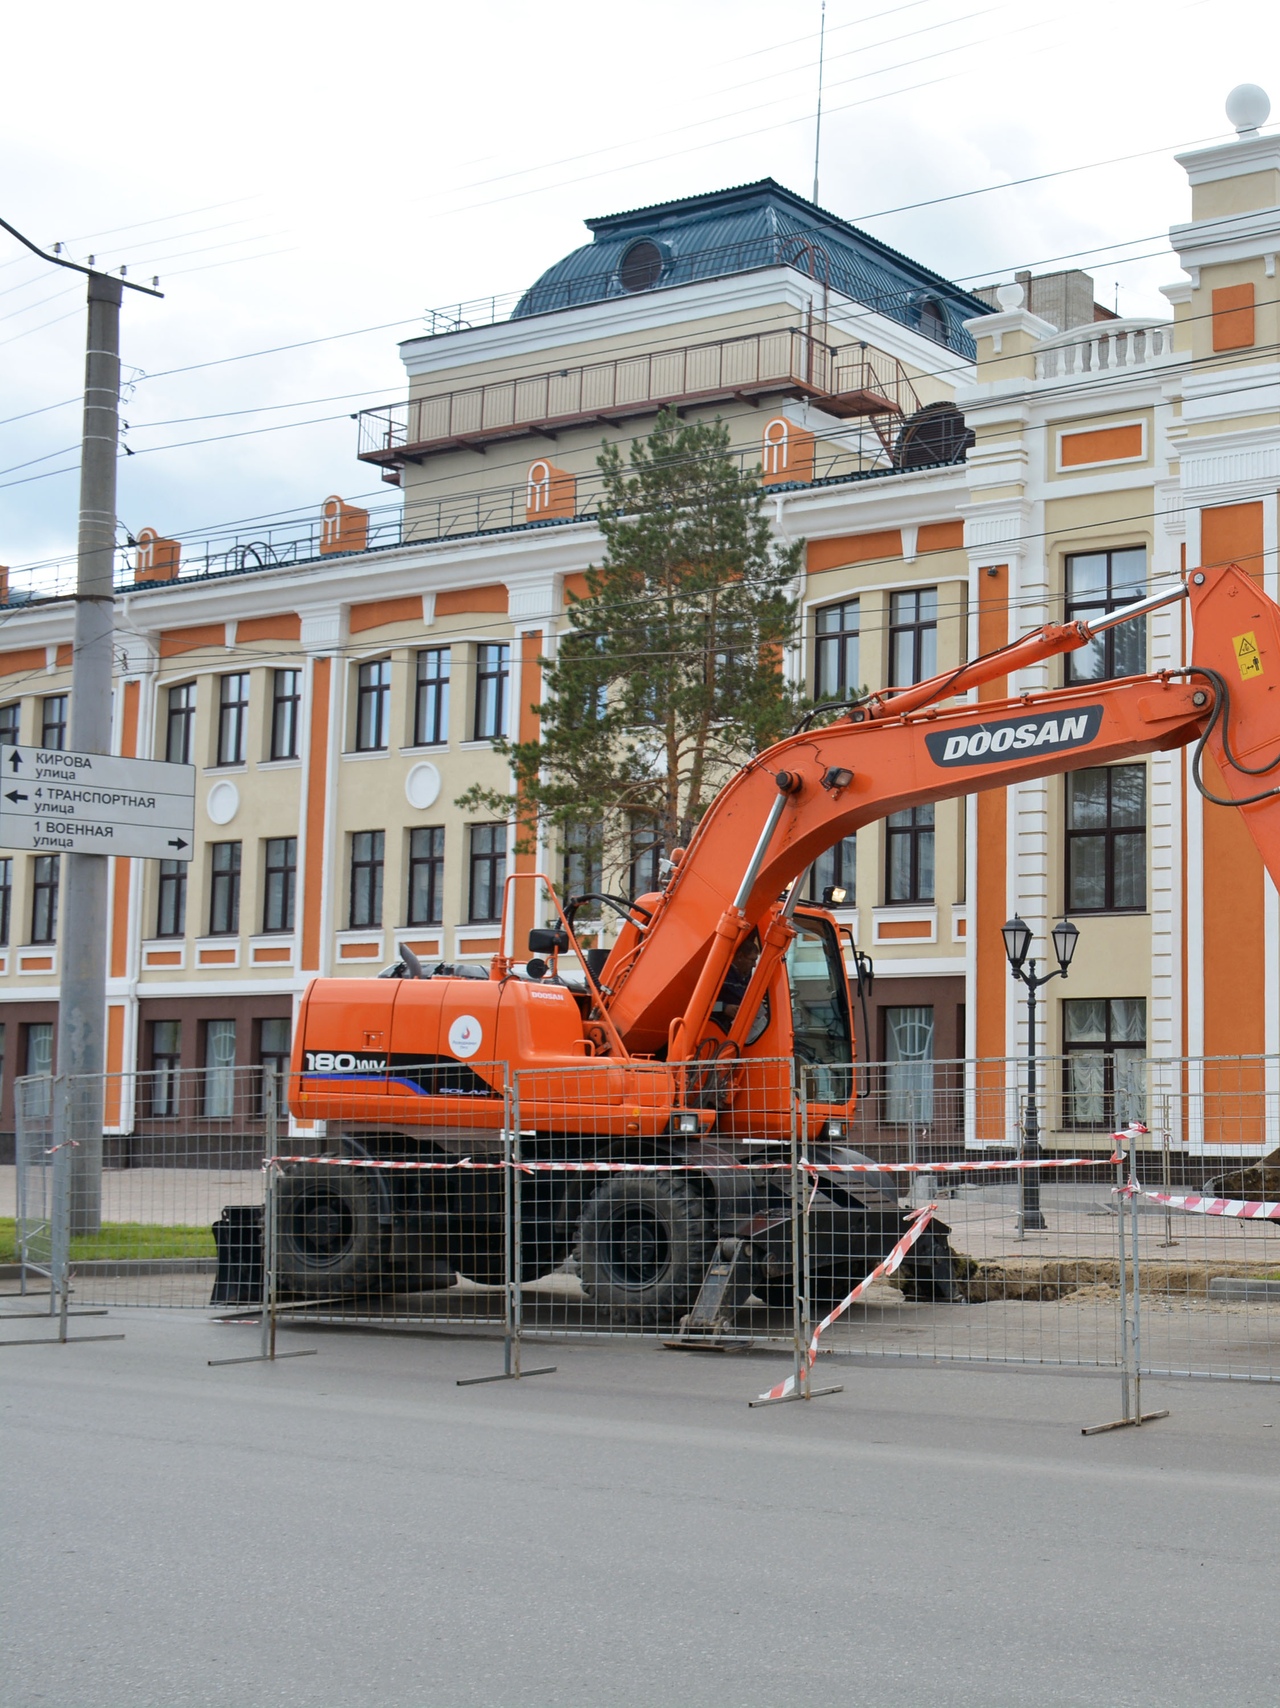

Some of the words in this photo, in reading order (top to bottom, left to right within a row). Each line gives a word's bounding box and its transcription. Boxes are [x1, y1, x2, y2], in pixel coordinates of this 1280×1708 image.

[943, 715, 1089, 761] DOOSAN
[36, 752, 92, 769] КИРОВА
[35, 768, 76, 780] улица
[34, 787, 43, 798] 4
[47, 788, 156, 809] ТРАНСПОРТНАЯ
[34, 802, 75, 814] улица
[34, 821, 40, 832] 1
[46, 822, 114, 838] ВОЕННАЯ
[33, 836, 74, 847] улица
[531, 991, 565, 1001] DOOSAN
[439, 1087, 488, 1096] SOLAR
